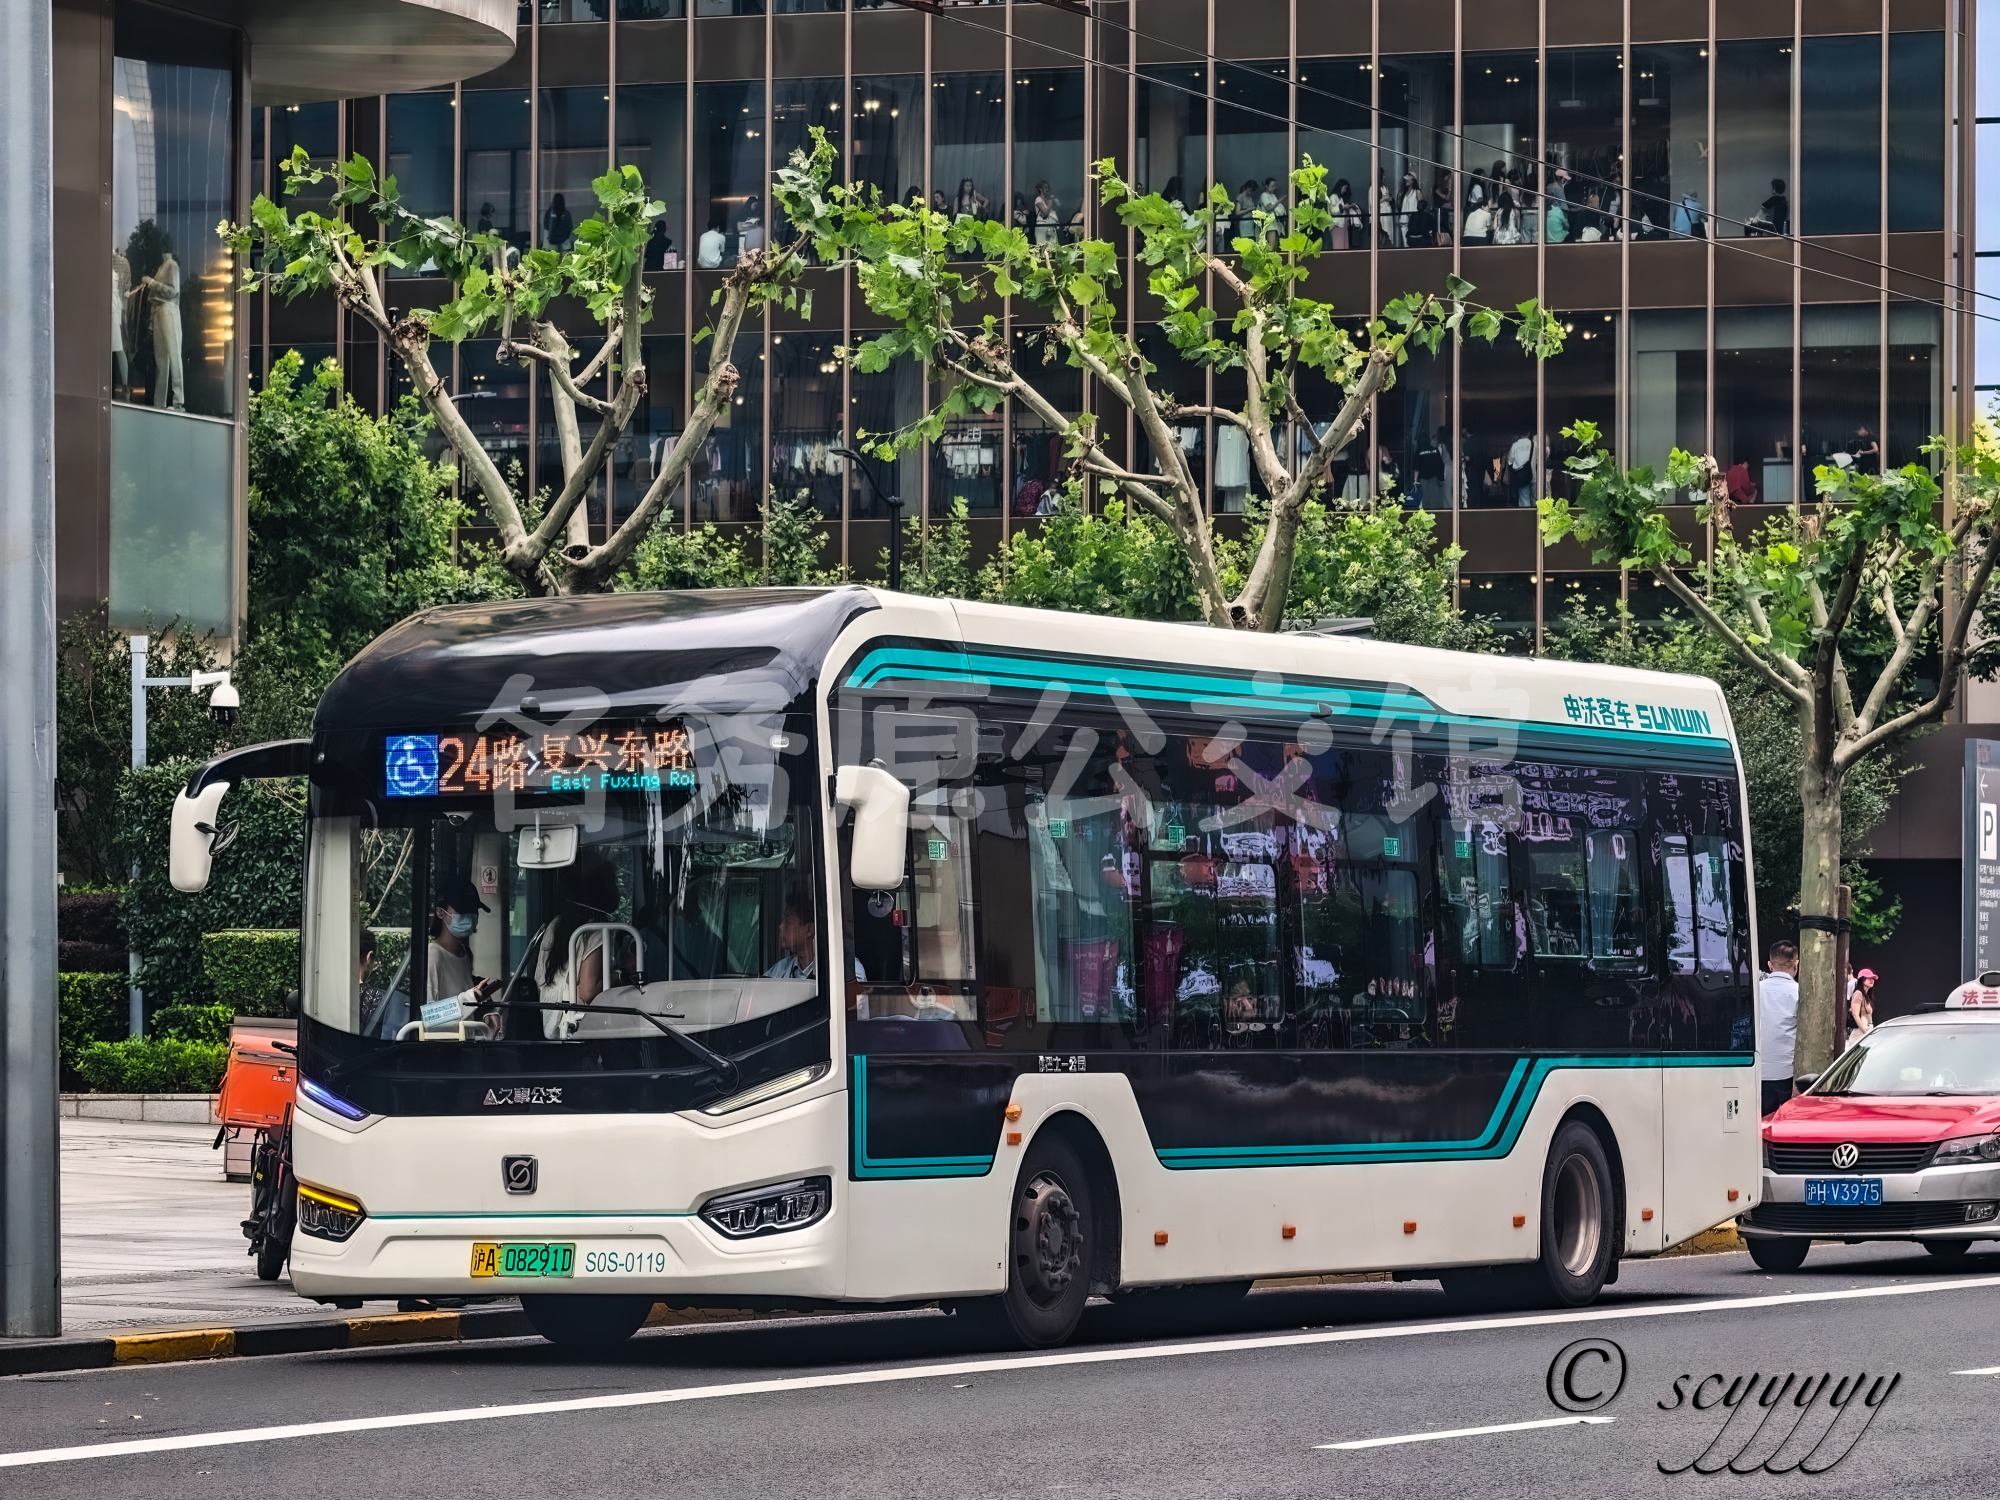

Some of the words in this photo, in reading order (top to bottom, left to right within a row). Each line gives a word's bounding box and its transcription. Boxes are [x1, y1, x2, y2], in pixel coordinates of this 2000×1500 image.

[1563, 693, 1634, 728] 申沃客车
[1635, 704, 1712, 734] SUNWIN
[438, 735, 527, 791] 24路
[541, 729, 688, 776] 复兴东路
[551, 774, 591, 790] East
[600, 773, 661, 789] Fuxing
